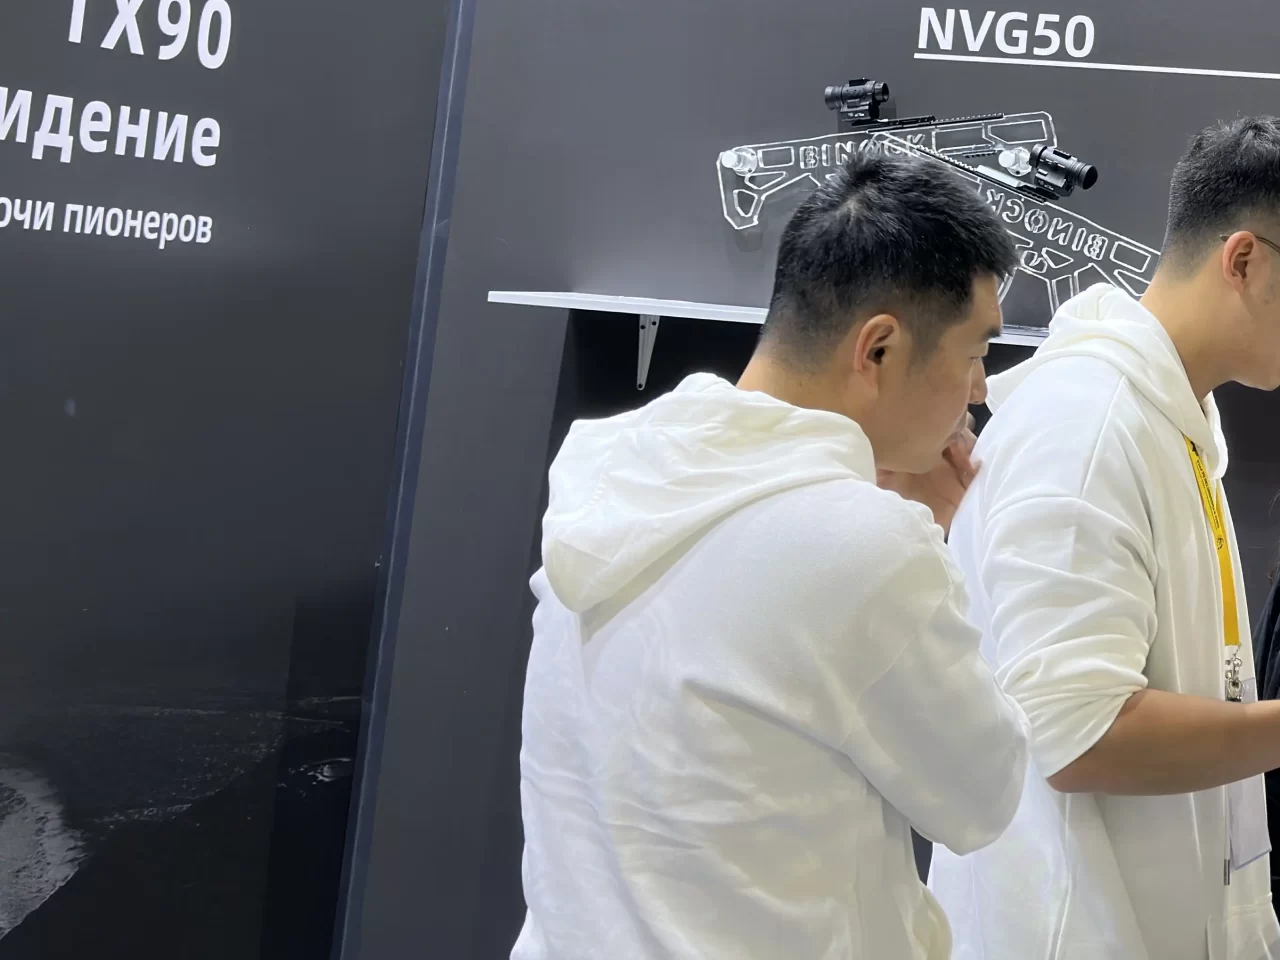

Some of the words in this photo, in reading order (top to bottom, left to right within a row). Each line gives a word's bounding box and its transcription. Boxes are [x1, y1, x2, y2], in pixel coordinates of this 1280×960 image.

[917, 7, 1095, 58] NVG50
[0, 87, 220, 167] идение
[63, 203, 212, 250] пионеров
